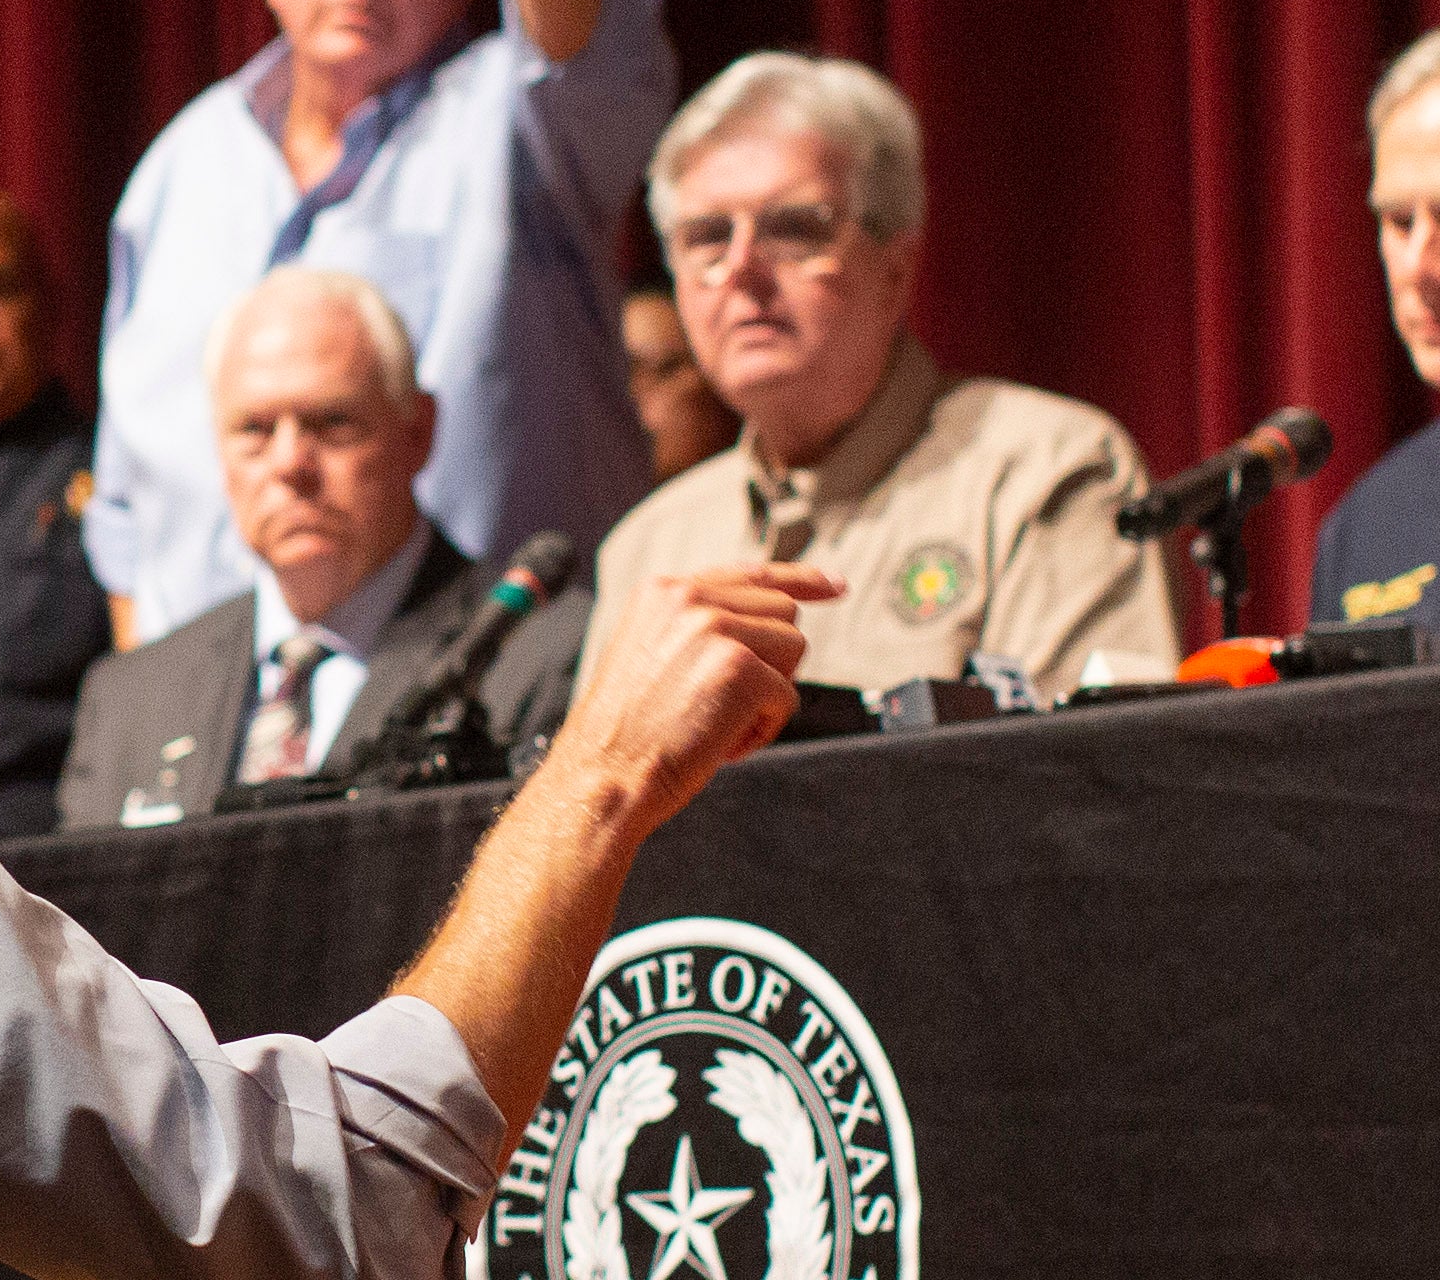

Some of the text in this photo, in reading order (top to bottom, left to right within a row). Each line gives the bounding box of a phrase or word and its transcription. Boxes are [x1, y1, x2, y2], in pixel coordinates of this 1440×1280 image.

[495, 952, 895, 1246] THE STATE OF TEXAS
